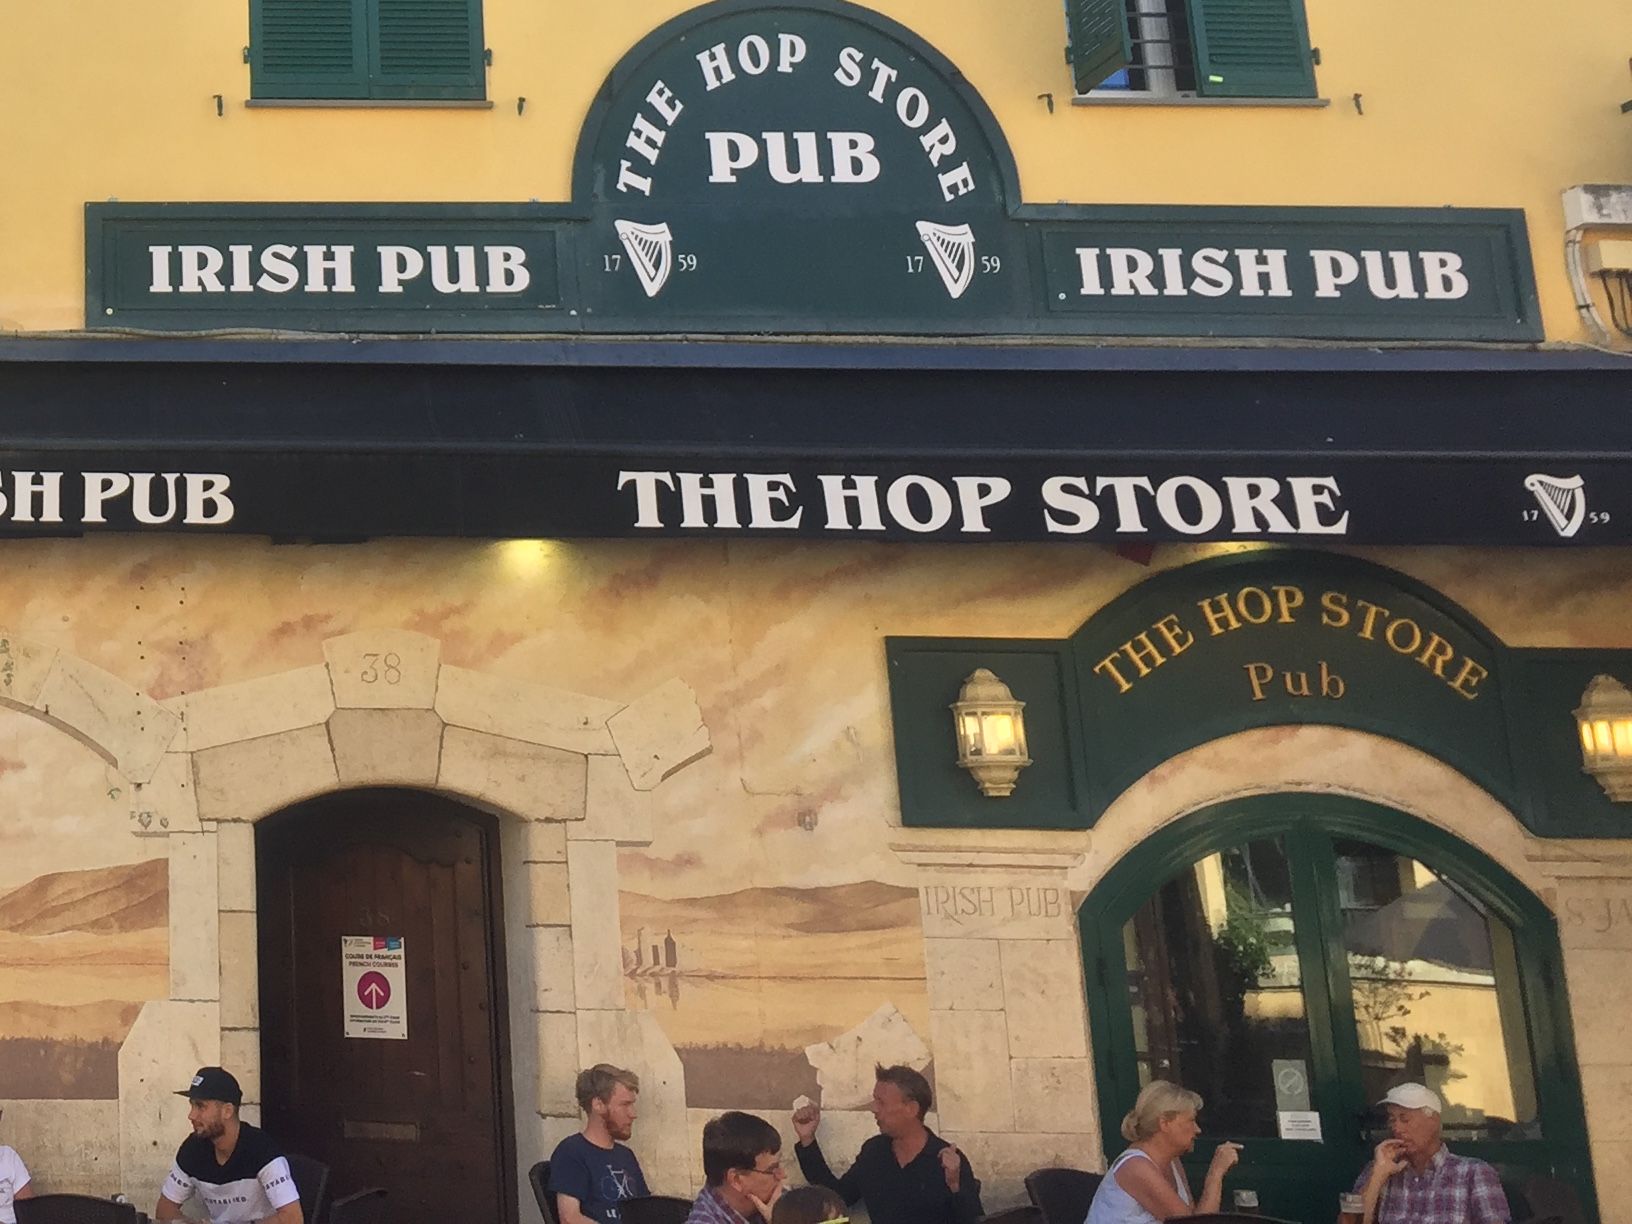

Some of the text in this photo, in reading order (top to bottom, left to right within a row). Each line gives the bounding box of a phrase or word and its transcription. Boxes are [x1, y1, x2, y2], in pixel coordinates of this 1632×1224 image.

[616, 33, 976, 203] THE HOP STORE
[704, 131, 881, 184] PUB
[148, 244, 530, 294] IRISH PUB
[603, 254, 697, 272] 17 59
[906, 255, 1001, 273] 17 59
[1075, 247, 1469, 300] IRISH PUB
[80, 471, 236, 526] PUB
[616, 470, 1350, 536] THE HOP STORE
[1522, 510, 1611, 524] 17 59
[1093, 585, 1489, 701] THE HOP STORE
[360, 652, 402, 685] 38
[1243, 661, 1346, 701] Pub
[924, 886, 1061, 925] IRISH PUB
